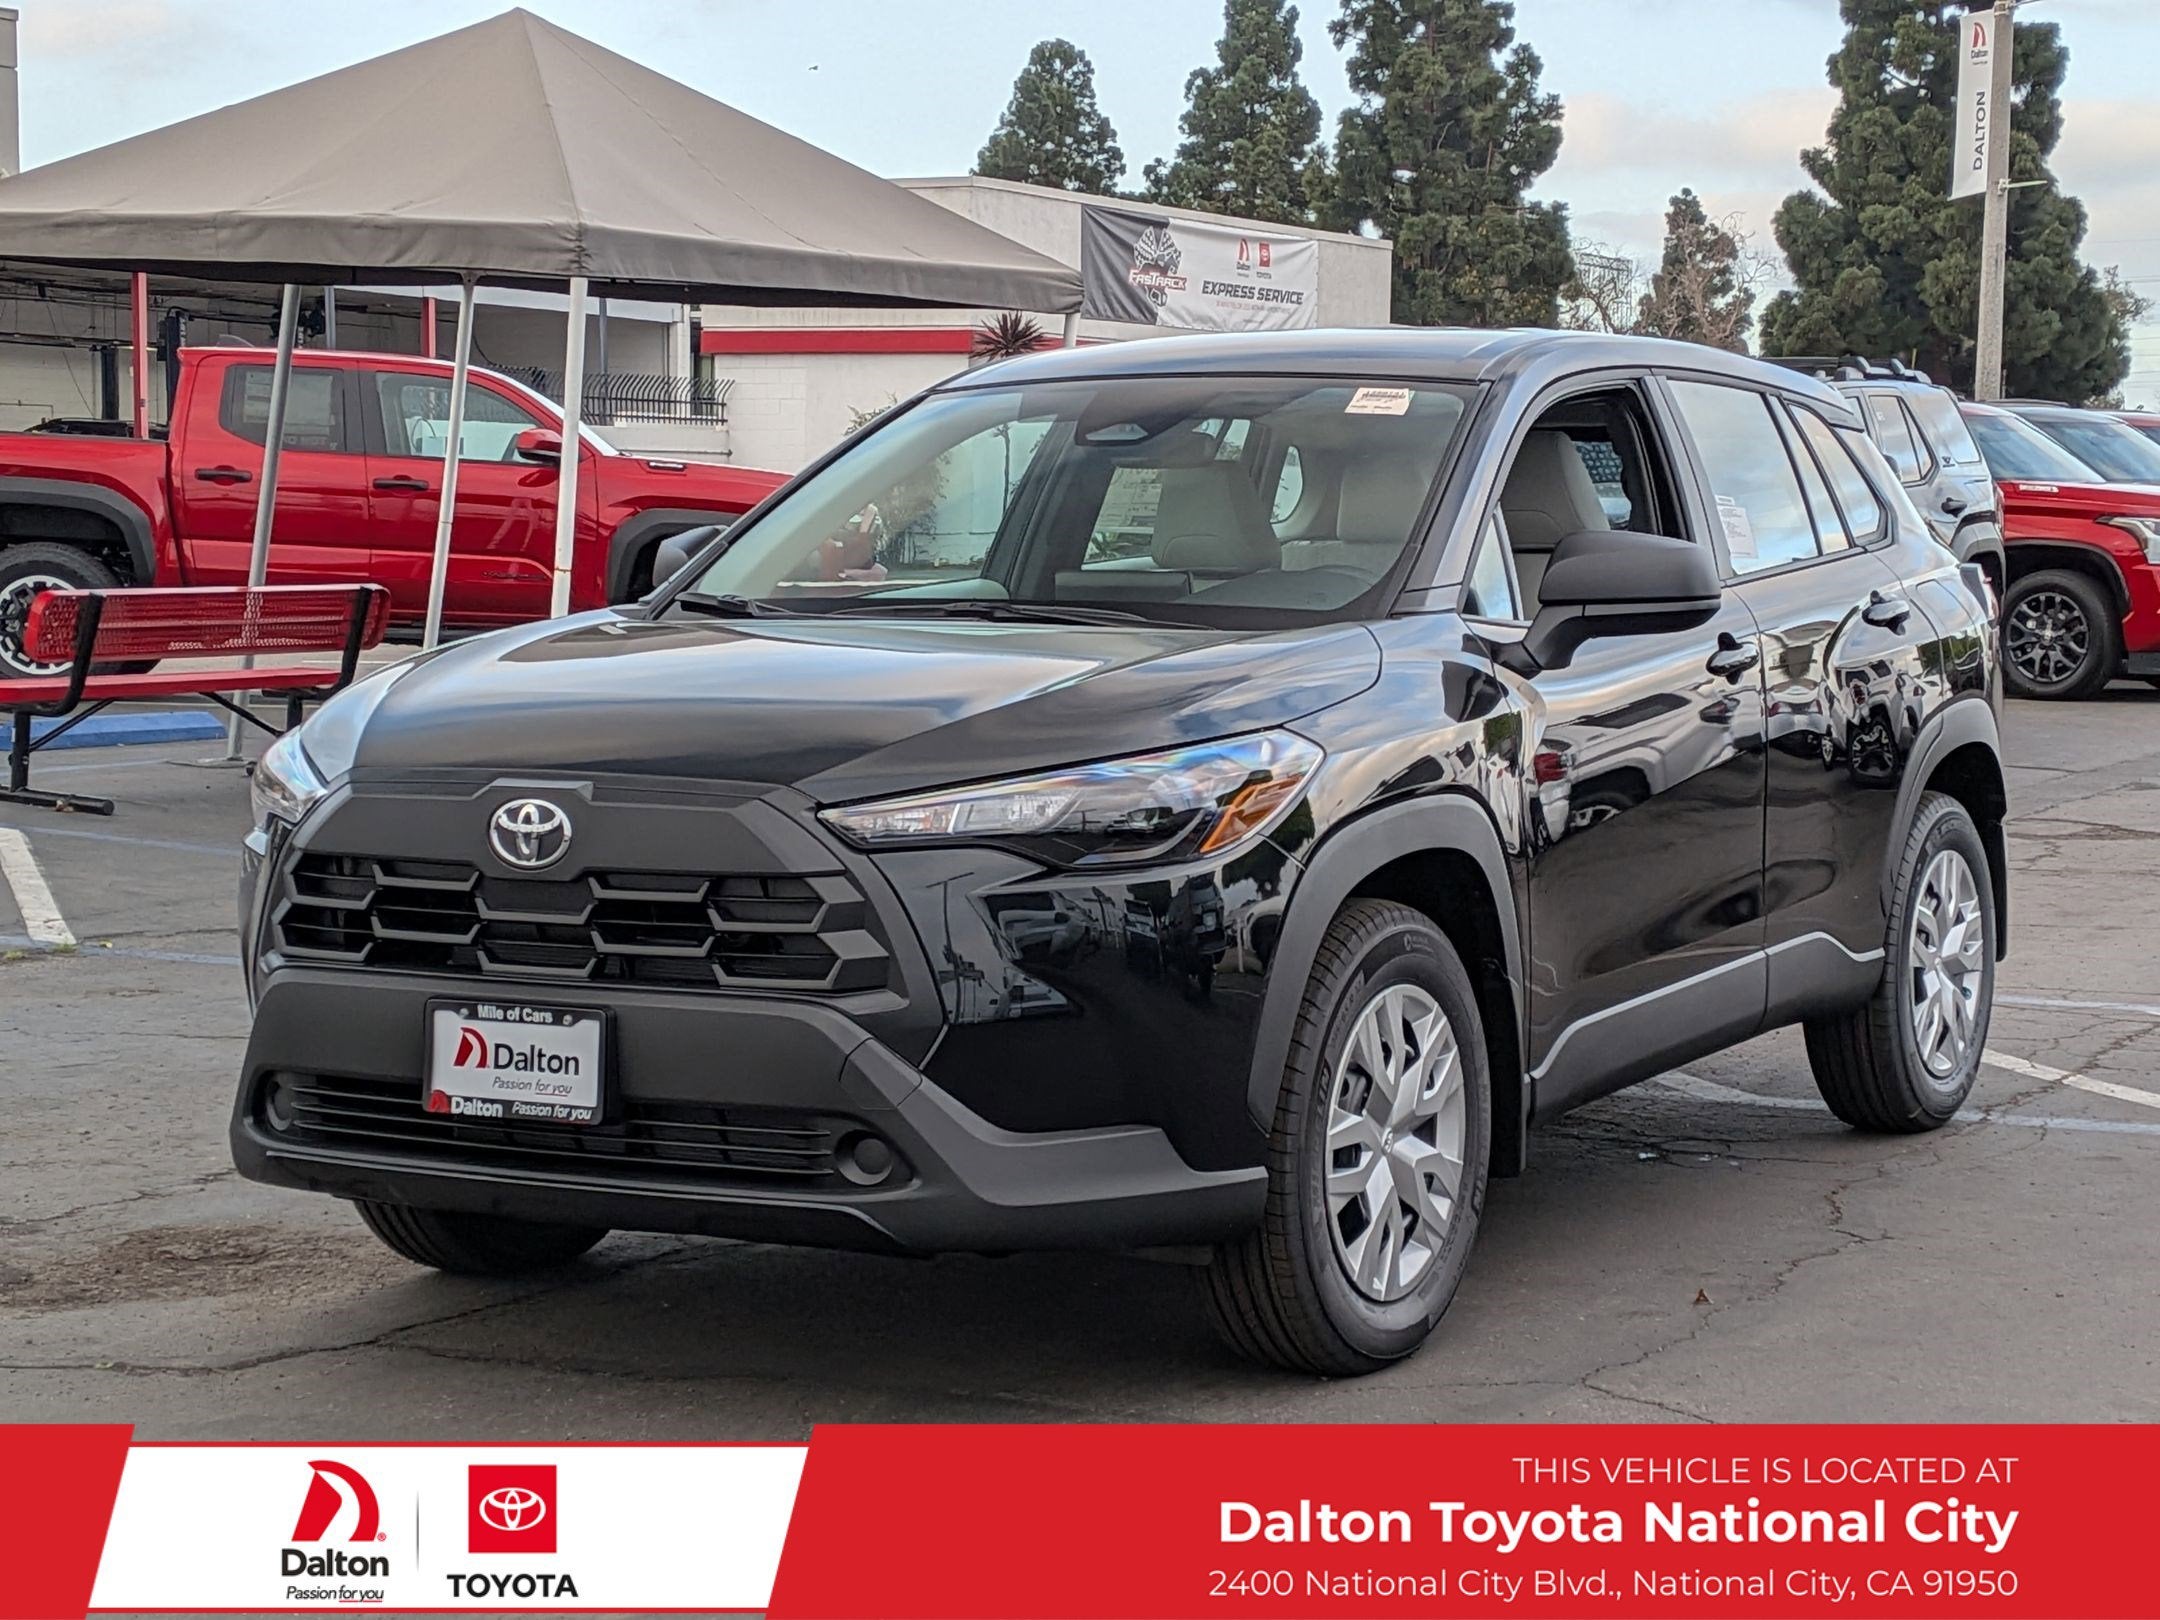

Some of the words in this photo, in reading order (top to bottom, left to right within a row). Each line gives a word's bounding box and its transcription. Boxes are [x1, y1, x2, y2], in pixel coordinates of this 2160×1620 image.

[1972, 91, 1986, 171] DALTON
[1202, 280, 1256, 300] EXPRESS
[1256, 287, 1305, 305] SERVICE
[477, 1004, 504, 1020] Mile
[506, 1006, 520, 1021] of
[522, 1008, 553, 1023] Cars
[493, 1043, 580, 1075] Dalton
[492, 1076, 532, 1091] Passion
[534, 1079, 551, 1094] for
[552, 1082, 573, 1095] you
[451, 1096, 503, 1118] Dalton
[511, 1101, 552, 1117] Passion
[552, 1104, 571, 1118] for
[571, 1107, 592, 1121] you
